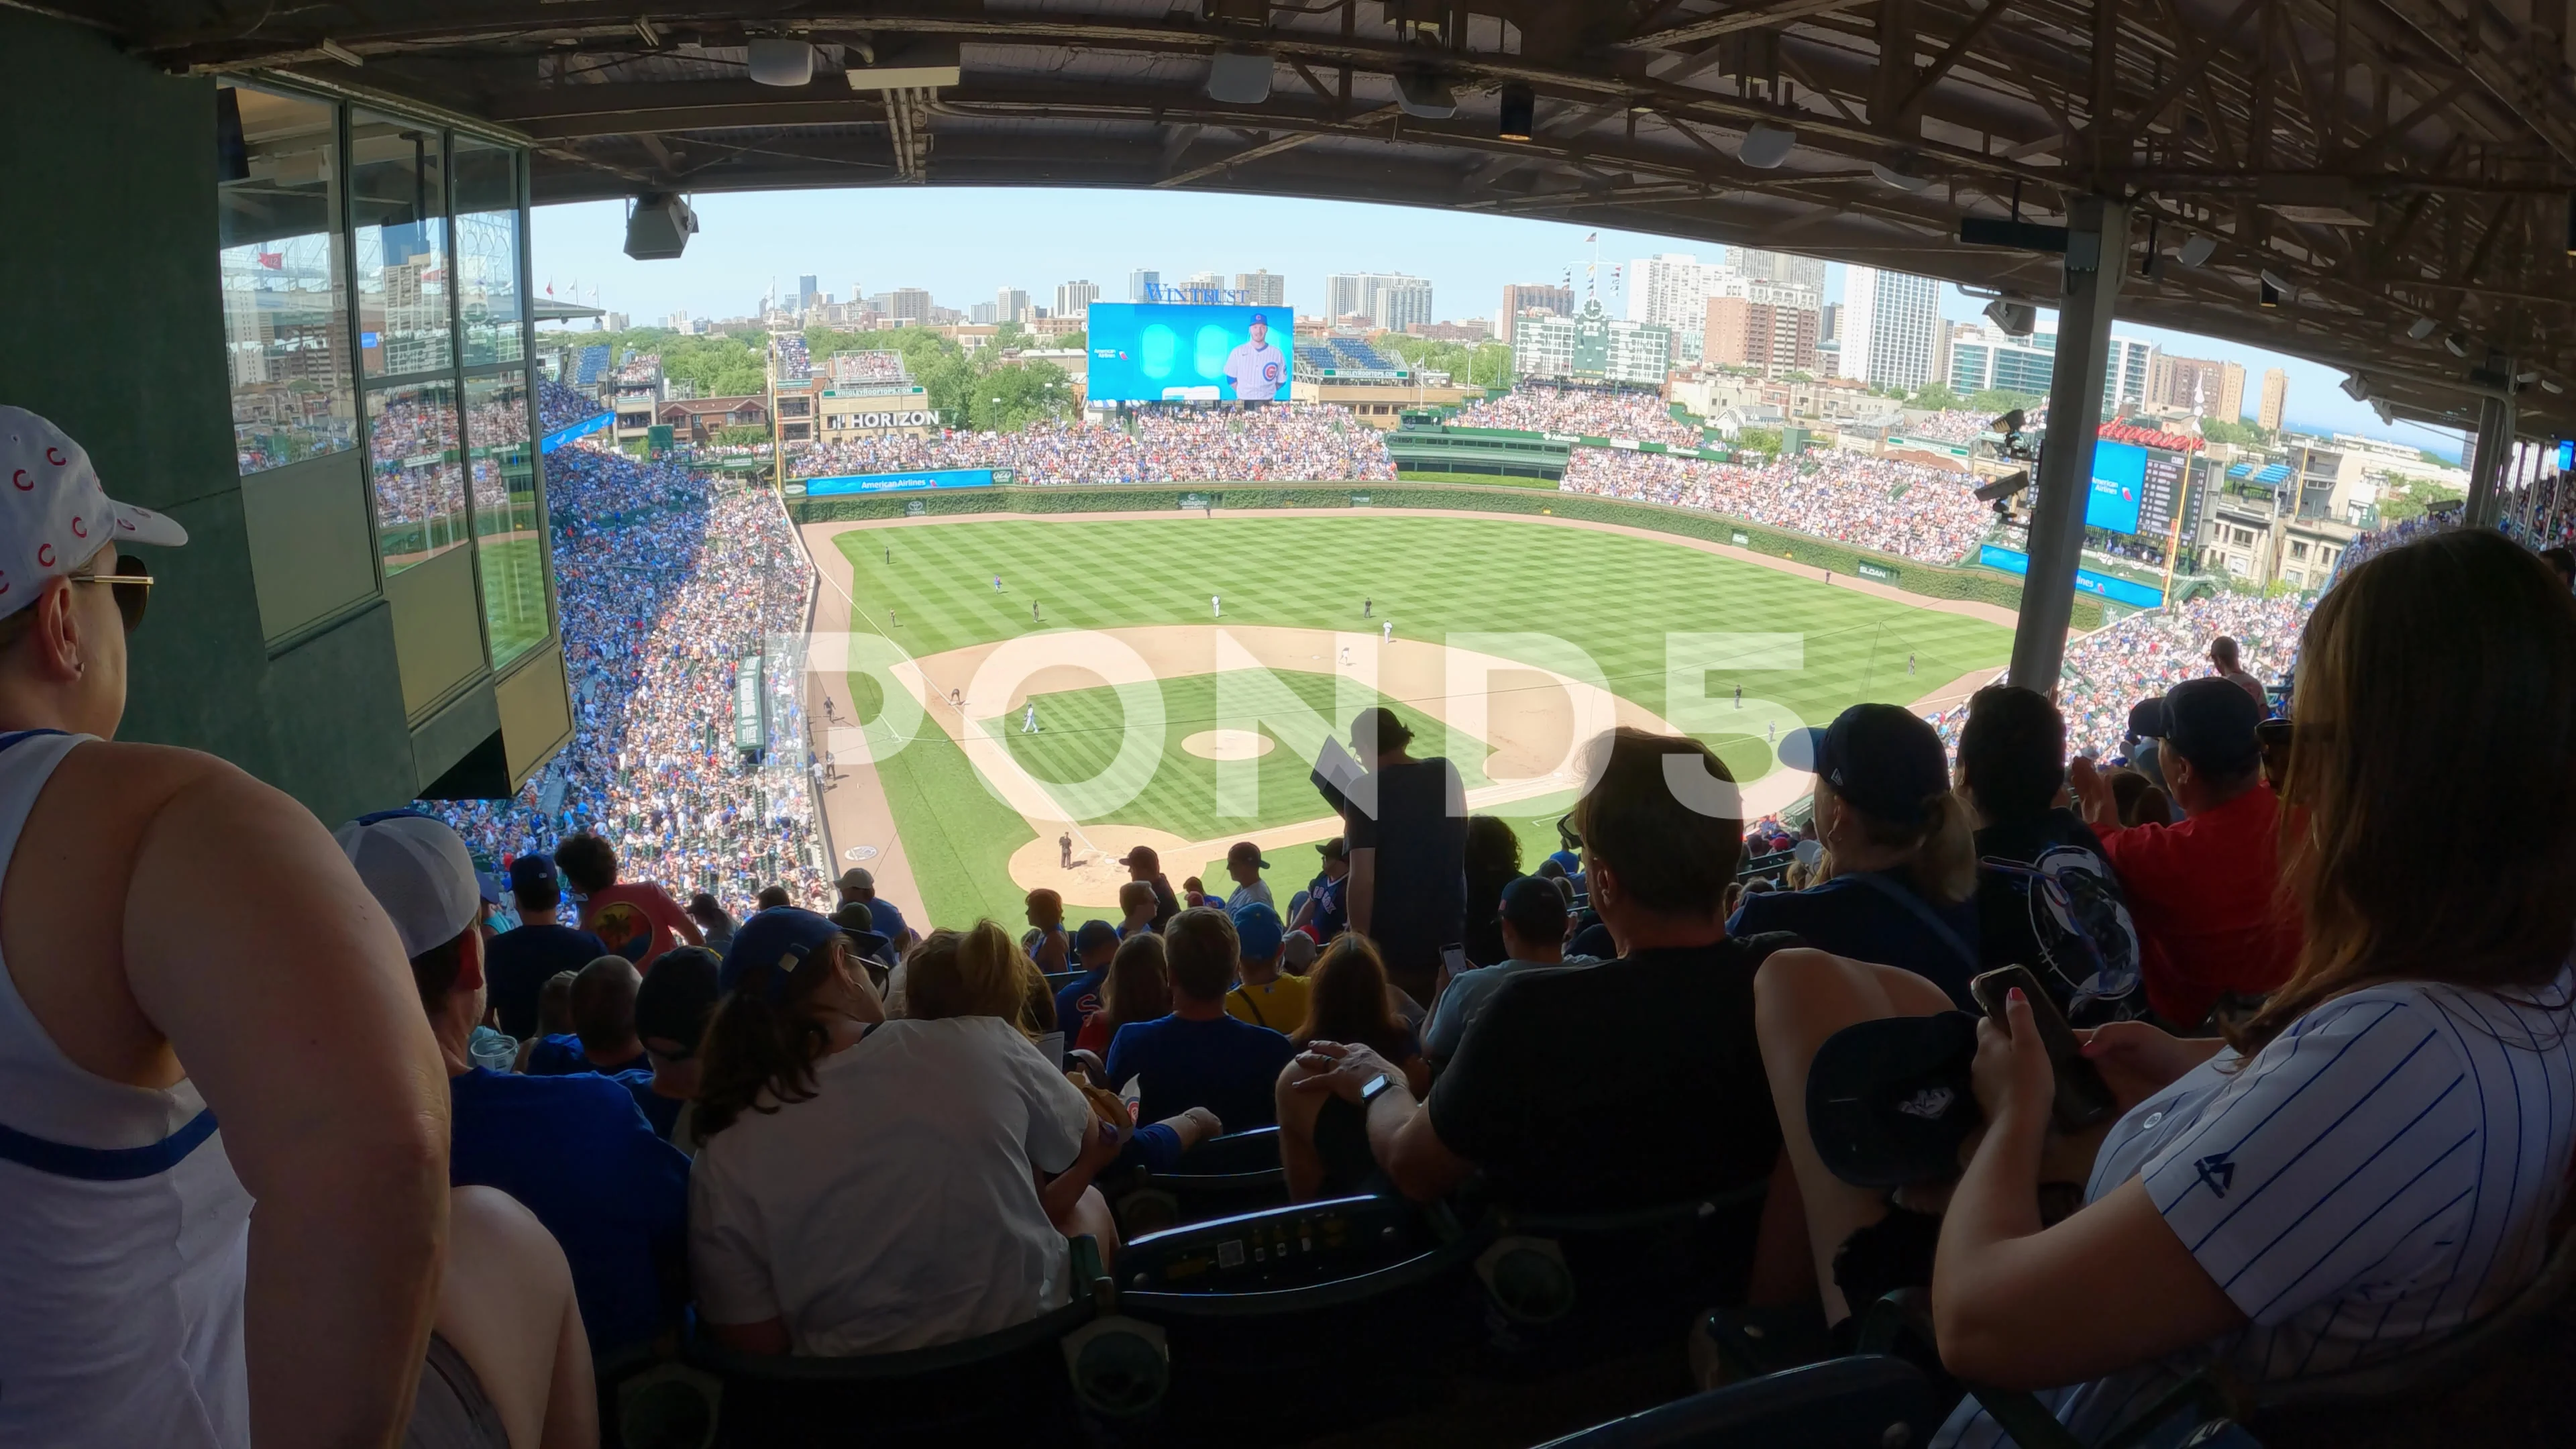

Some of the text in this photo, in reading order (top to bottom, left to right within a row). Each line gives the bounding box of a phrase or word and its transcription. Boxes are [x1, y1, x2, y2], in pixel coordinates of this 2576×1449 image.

[1144, 282, 1249, 303] WINTRUST
[851, 410, 938, 428] HORIZON
[861, 478, 926, 489] American Airlines
[2095, 485, 2118, 495] Airlines
[1860, 566, 1886, 578] SLOAN
[2077, 575, 2094, 588] lines
